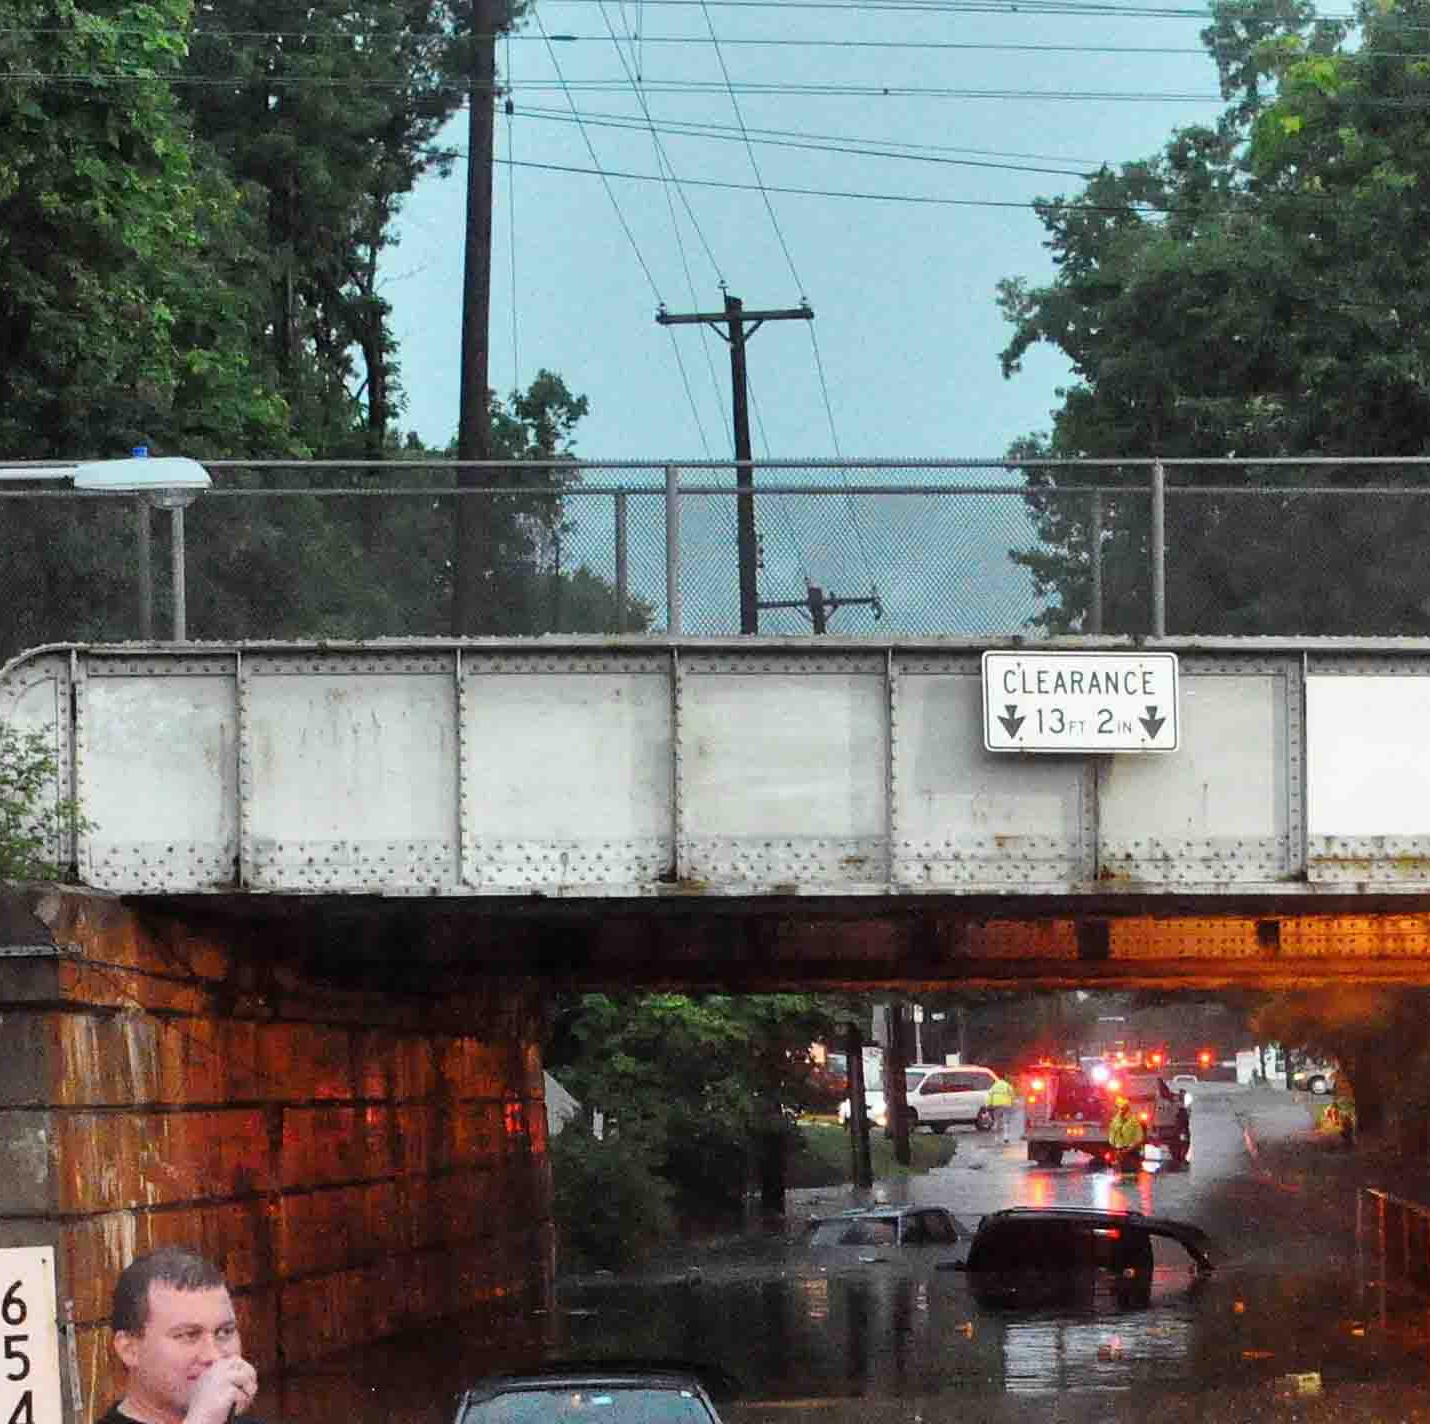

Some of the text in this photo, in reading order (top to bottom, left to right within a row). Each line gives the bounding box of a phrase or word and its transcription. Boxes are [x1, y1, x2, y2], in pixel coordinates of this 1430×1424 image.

[1003, 669, 1156, 695] CLEARANCE
[1, 1279, 28, 1326] 6
[3, 1333, 31, 1382] 5
